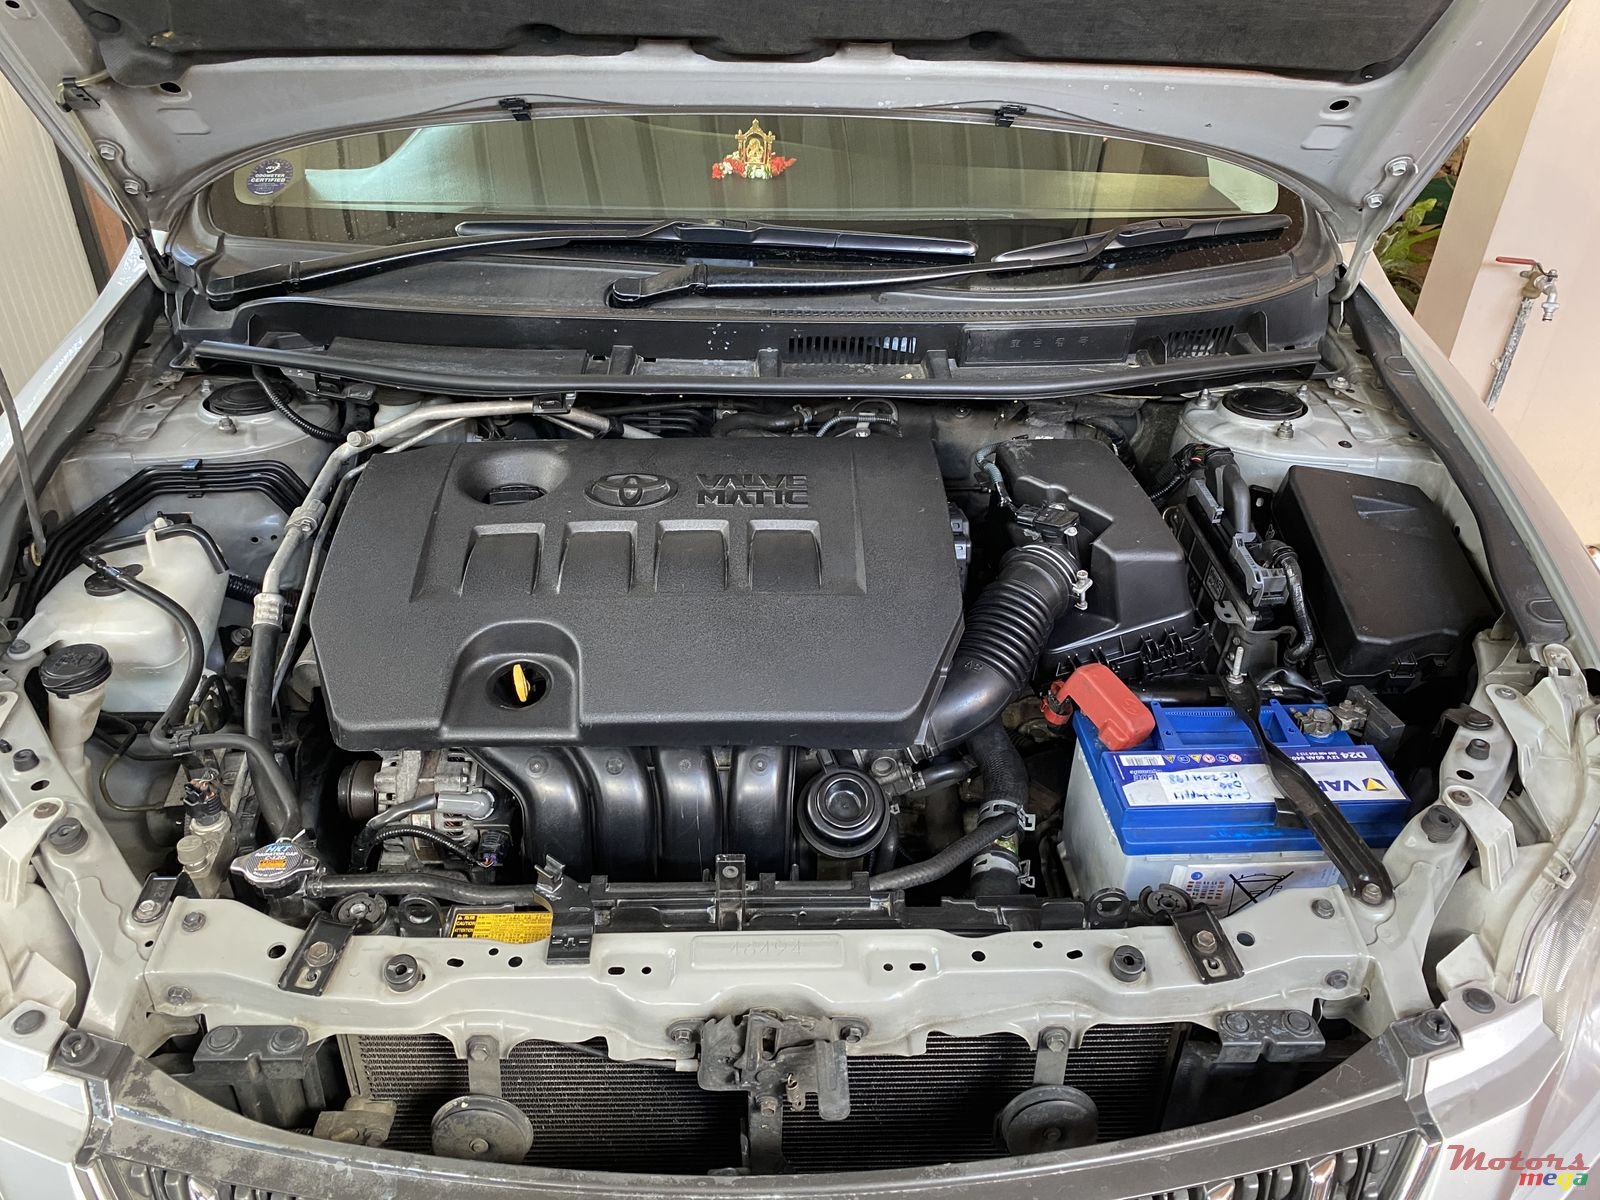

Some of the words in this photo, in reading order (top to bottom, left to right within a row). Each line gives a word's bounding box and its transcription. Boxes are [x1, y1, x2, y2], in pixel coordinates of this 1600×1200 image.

[695, 473, 808, 490] VALVE
[696, 489, 809, 508] MATIC
[1339, 751, 1368, 759] D24
